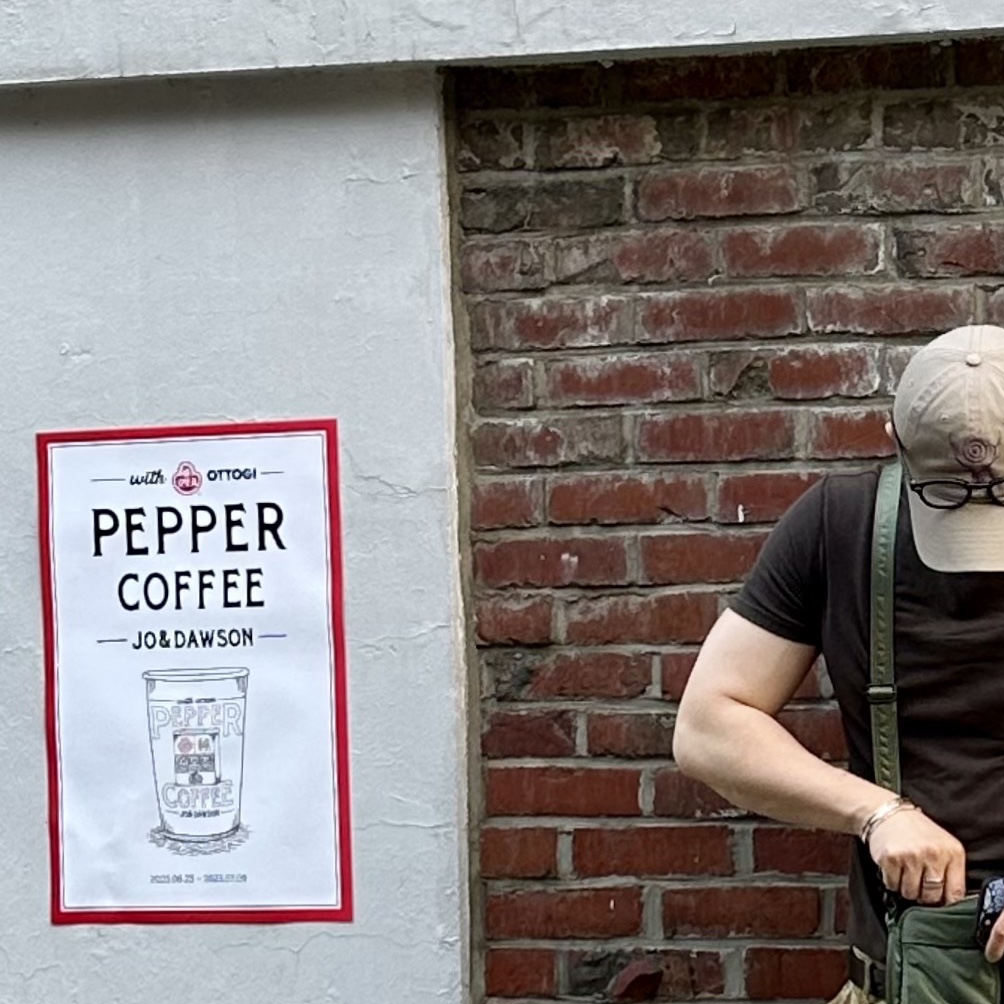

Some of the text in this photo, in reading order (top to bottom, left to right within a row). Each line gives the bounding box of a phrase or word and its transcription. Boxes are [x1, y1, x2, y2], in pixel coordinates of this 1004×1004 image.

[129, 469, 165, 486] with
[206, 467, 257, 482] OTTOGI
[92, 502, 287, 557] PEPPER
[117, 568, 265, 611] COFFEE
[132, 628, 254, 650] JO&DAWSON
